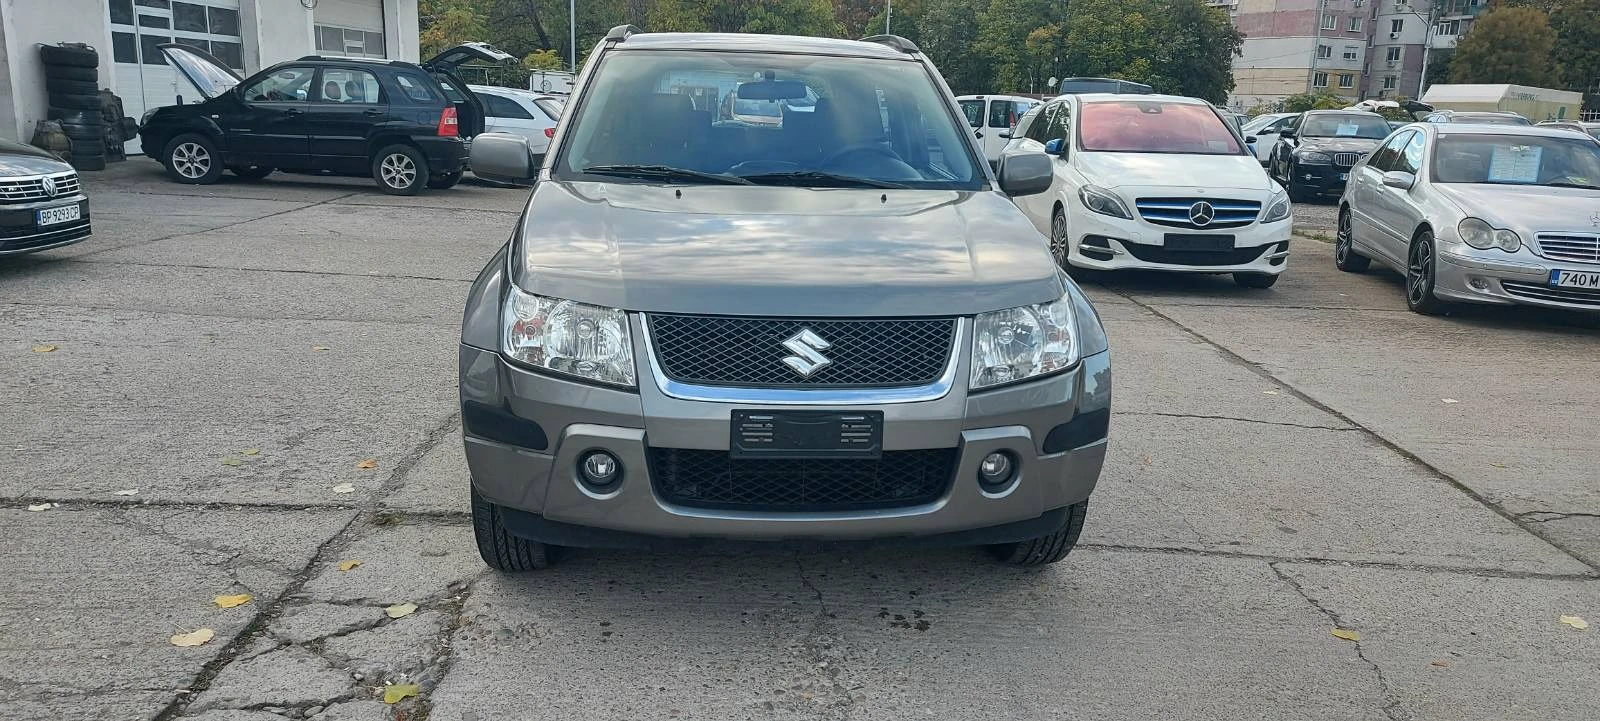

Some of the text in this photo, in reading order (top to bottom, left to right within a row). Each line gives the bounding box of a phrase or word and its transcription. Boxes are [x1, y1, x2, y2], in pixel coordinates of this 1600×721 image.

[42, 211, 51, 223] BP
[53, 208, 69, 221] 9293
[71, 206, 79, 218] CP
[1561, 273, 1599, 287] 740 M
